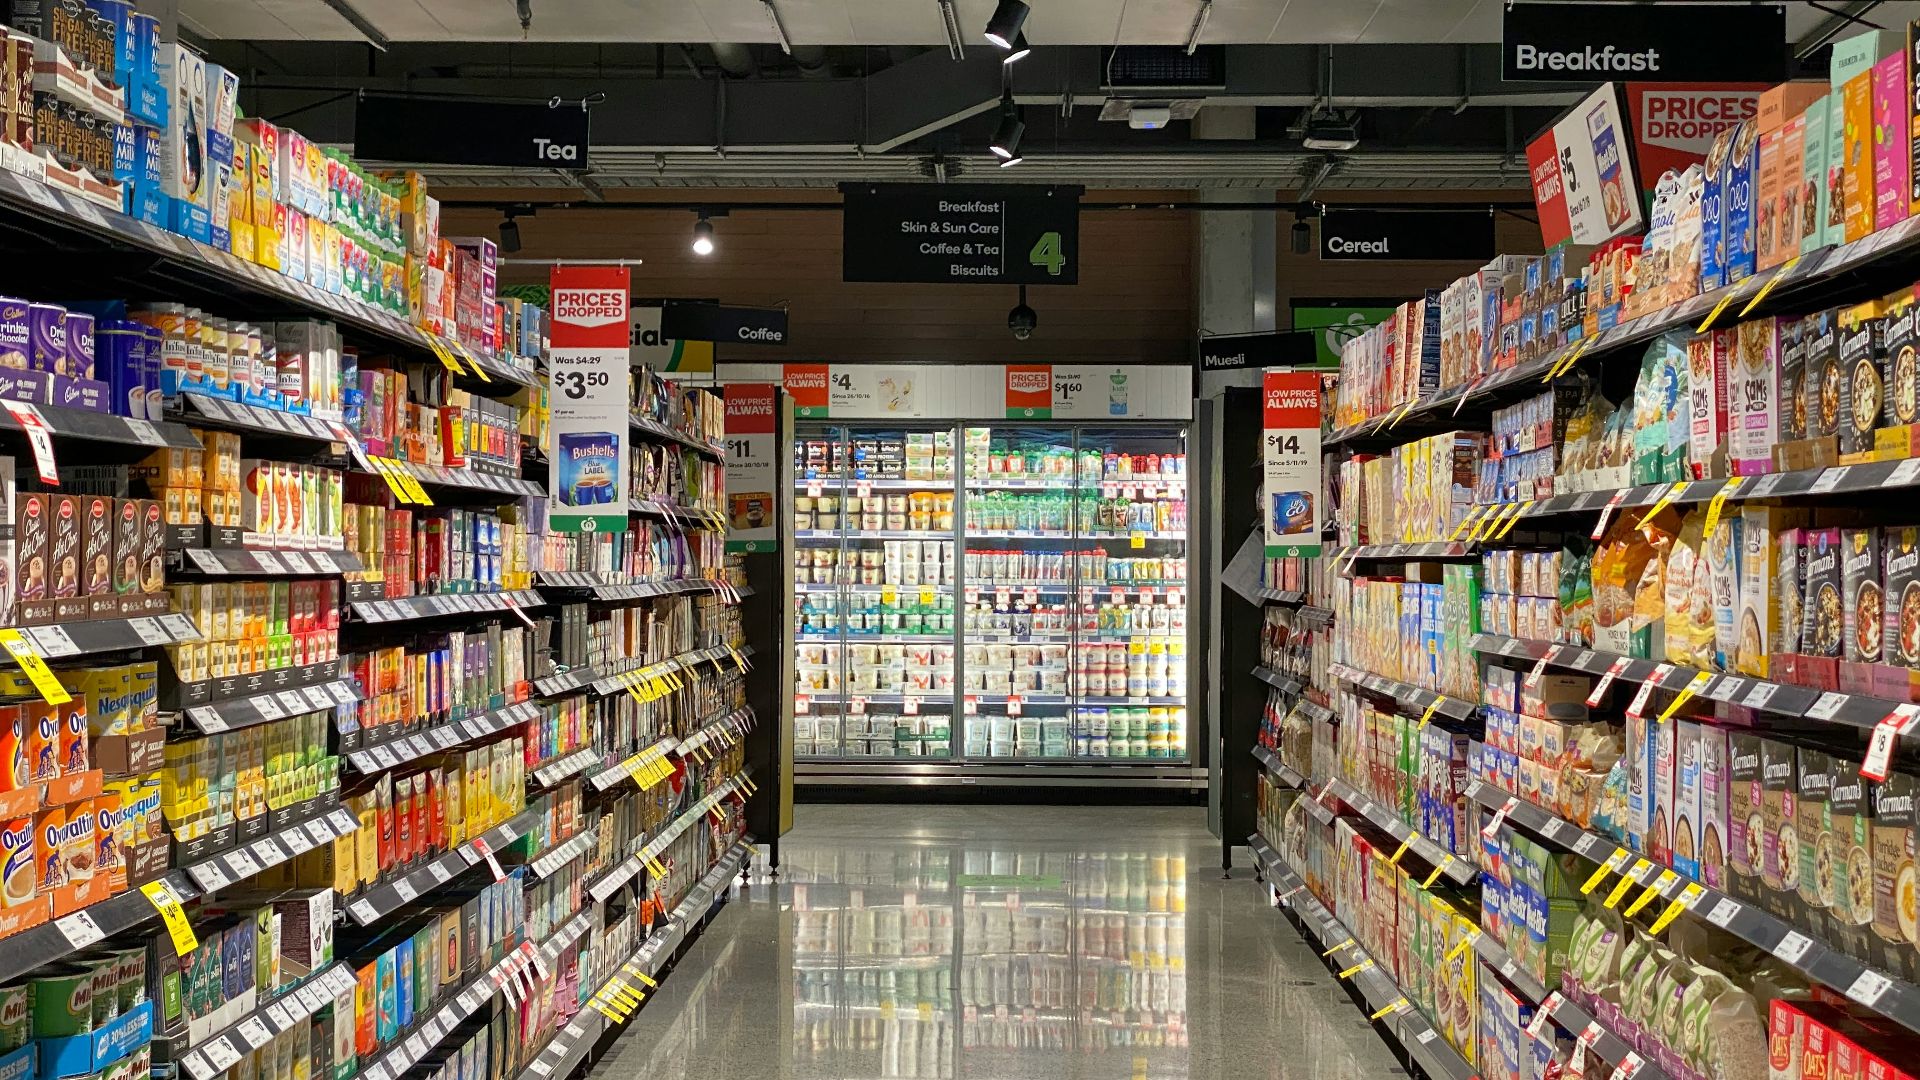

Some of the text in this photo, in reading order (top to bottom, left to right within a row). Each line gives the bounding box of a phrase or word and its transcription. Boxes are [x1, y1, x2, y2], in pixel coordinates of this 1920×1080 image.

[1516, 45, 1659, 71] Breakfast
[1648, 97, 1758, 120] PRICES
[533, 138, 577, 160] Tea
[1537, 174, 1561, 204] ALWAYS
[939, 201, 999, 213] Breakfast
[901, 221, 999, 234] Skin & Sun Care
[920, 243, 999, 255] Coffee & Tea
[1328, 236, 1389, 253] Cereal
[1030, 231, 1066, 275] 4
[951, 264, 999, 276] Biscuits
[558, 293, 622, 306] PRICES
[558, 307, 622, 317] DROPPED
[738, 327, 783, 341] Coffee
[555, 356, 601, 365] Was $4.29
[1205, 353, 1245, 367] Muesli
[786, 380, 826, 388] ALWAYS
[832, 373, 852, 391] $4
[1011, 374, 1047, 382] PRICES
[727, 406, 772, 415] ALWAYS
[1267, 399, 1318, 408] ALWAYS
[728, 440, 750, 458] $11
[1268, 435, 1300, 454] $14
[573, 444, 615, 460] Bushells
[584, 466, 605, 475] LABEL
[1771, 1033, 1788, 1057] OATS
[1804, 1051, 1826, 1078] OATS
